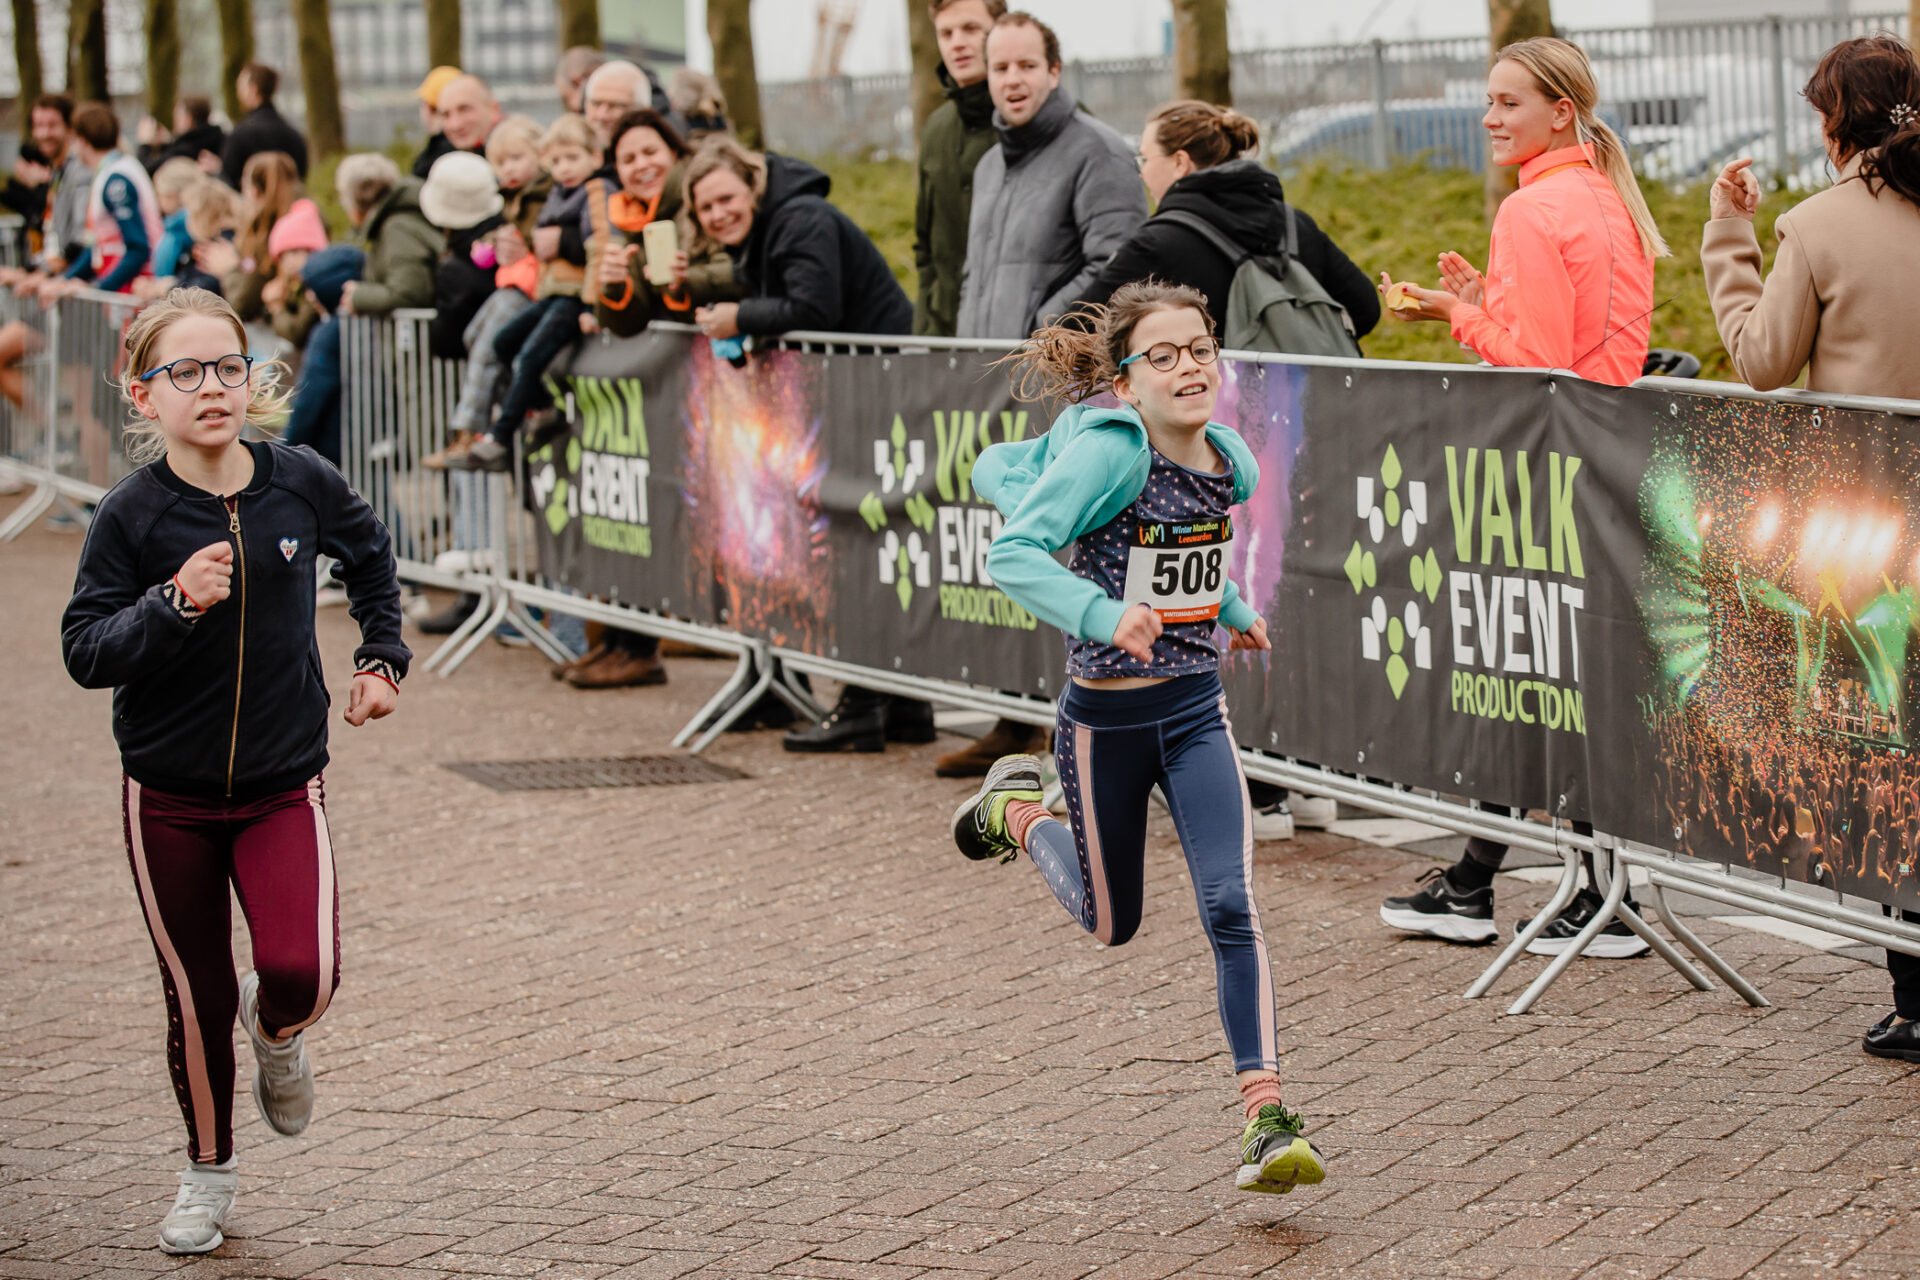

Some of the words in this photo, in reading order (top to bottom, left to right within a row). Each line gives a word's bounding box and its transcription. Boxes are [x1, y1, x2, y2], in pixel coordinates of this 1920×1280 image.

[580, 450, 650, 525] EVENT
[1445, 445, 1586, 579] VALK
[1172, 525, 1192, 534] Winter
[1192, 521, 1219, 533] Marathon
[1178, 531, 1213, 544] Leeuwarden
[1151, 548, 1222, 596] 508
[1449, 570, 1585, 682] EVENT
